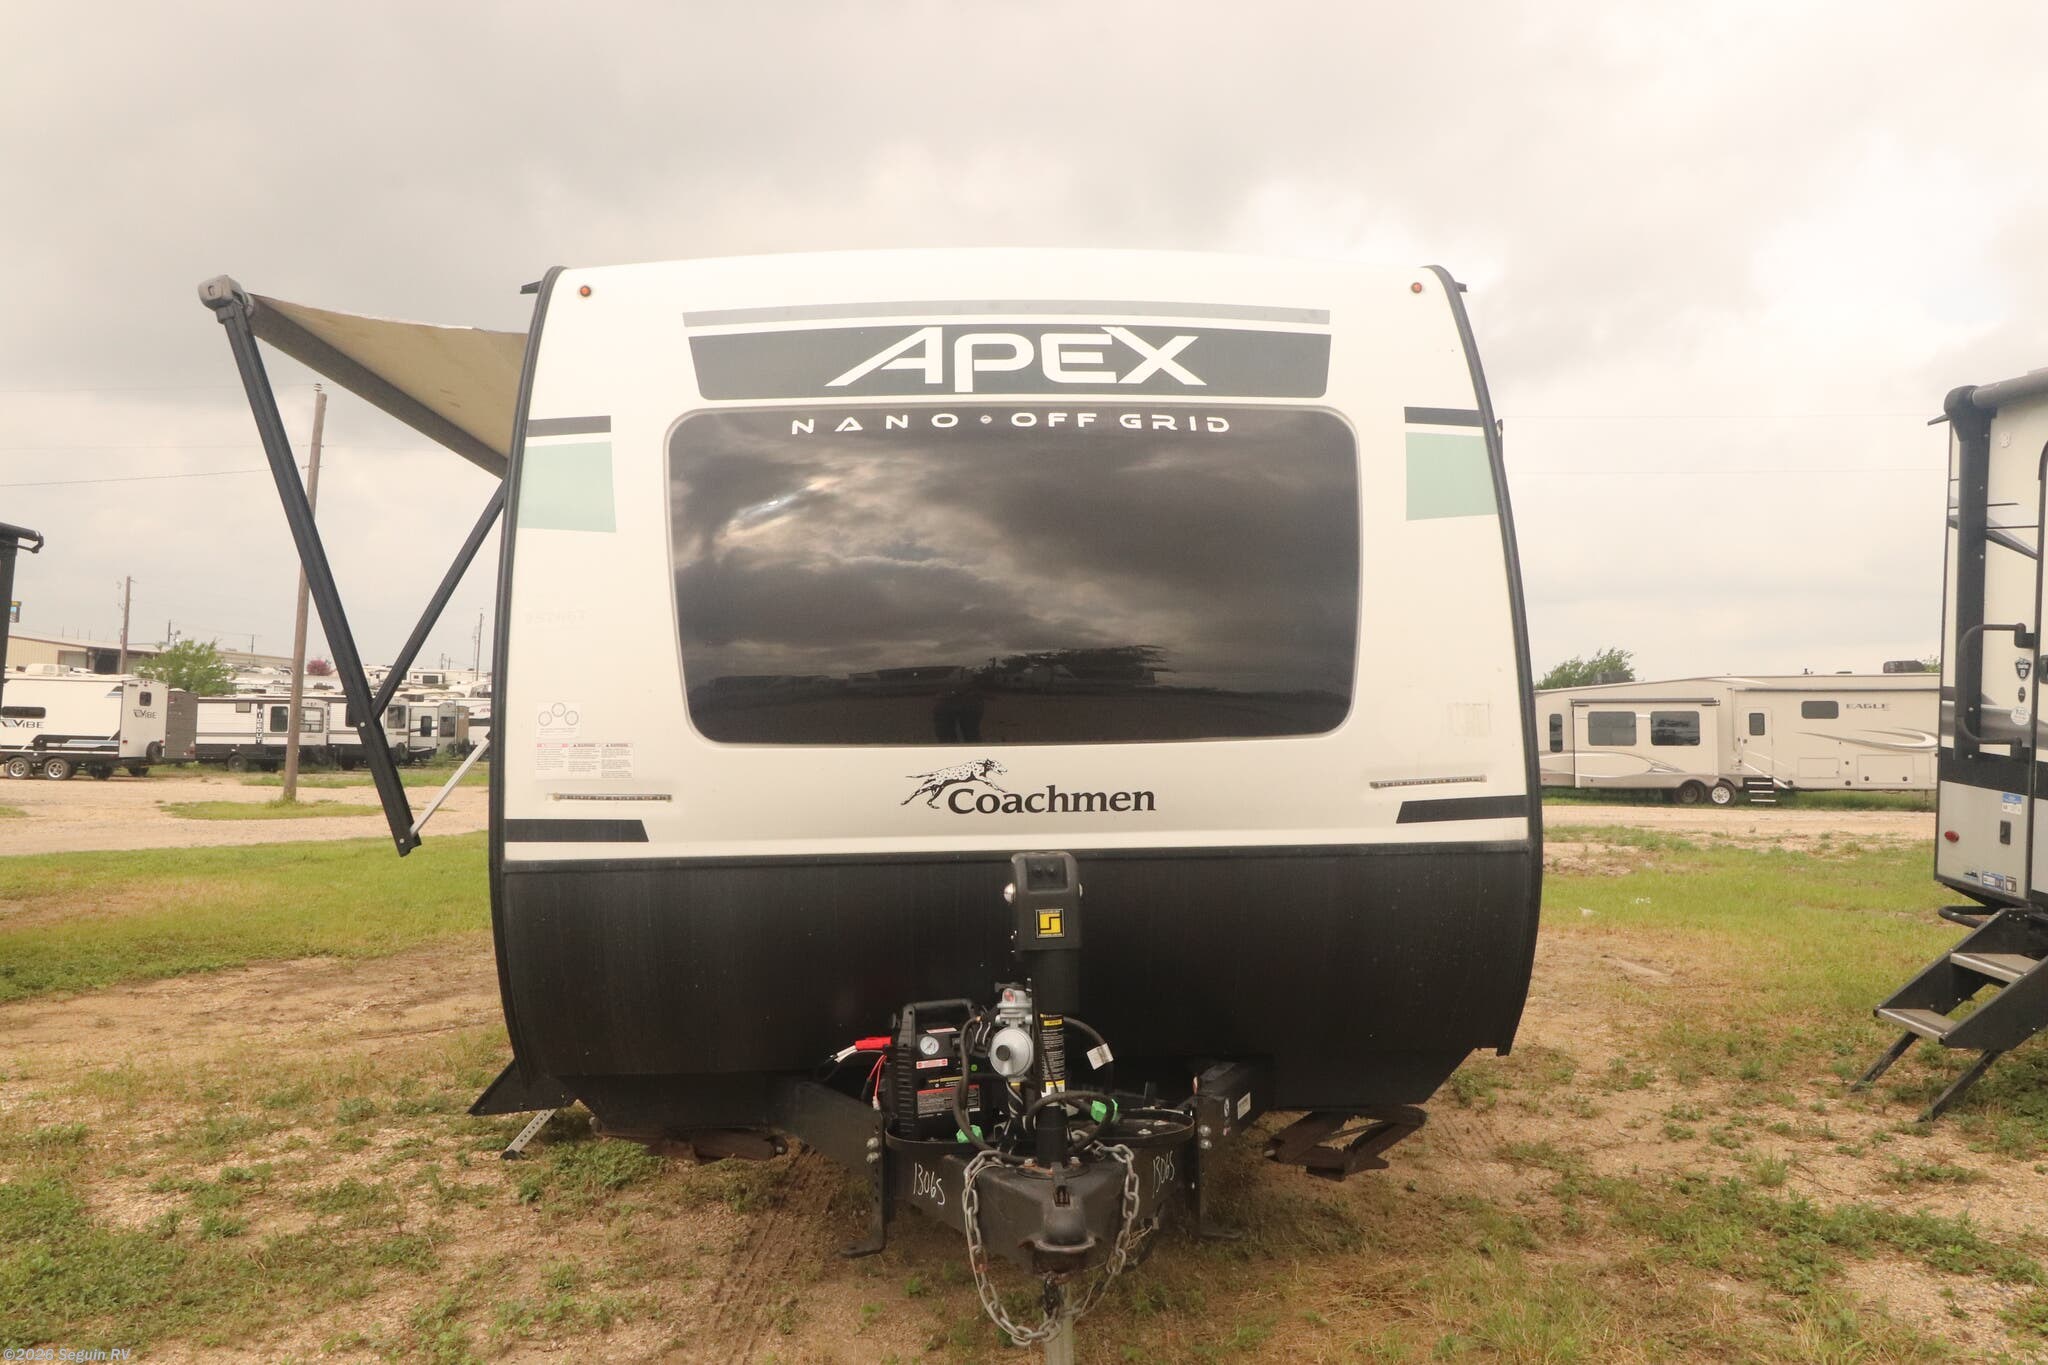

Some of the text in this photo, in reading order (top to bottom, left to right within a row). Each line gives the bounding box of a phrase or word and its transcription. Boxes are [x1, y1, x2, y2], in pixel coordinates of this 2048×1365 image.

[824, 326, 1208, 393] APEX
[791, 412, 1231, 435] NANO OFF GRID
[1846, 703, 1889, 711] EAGLE
[947, 784, 1157, 815] Coachmen
